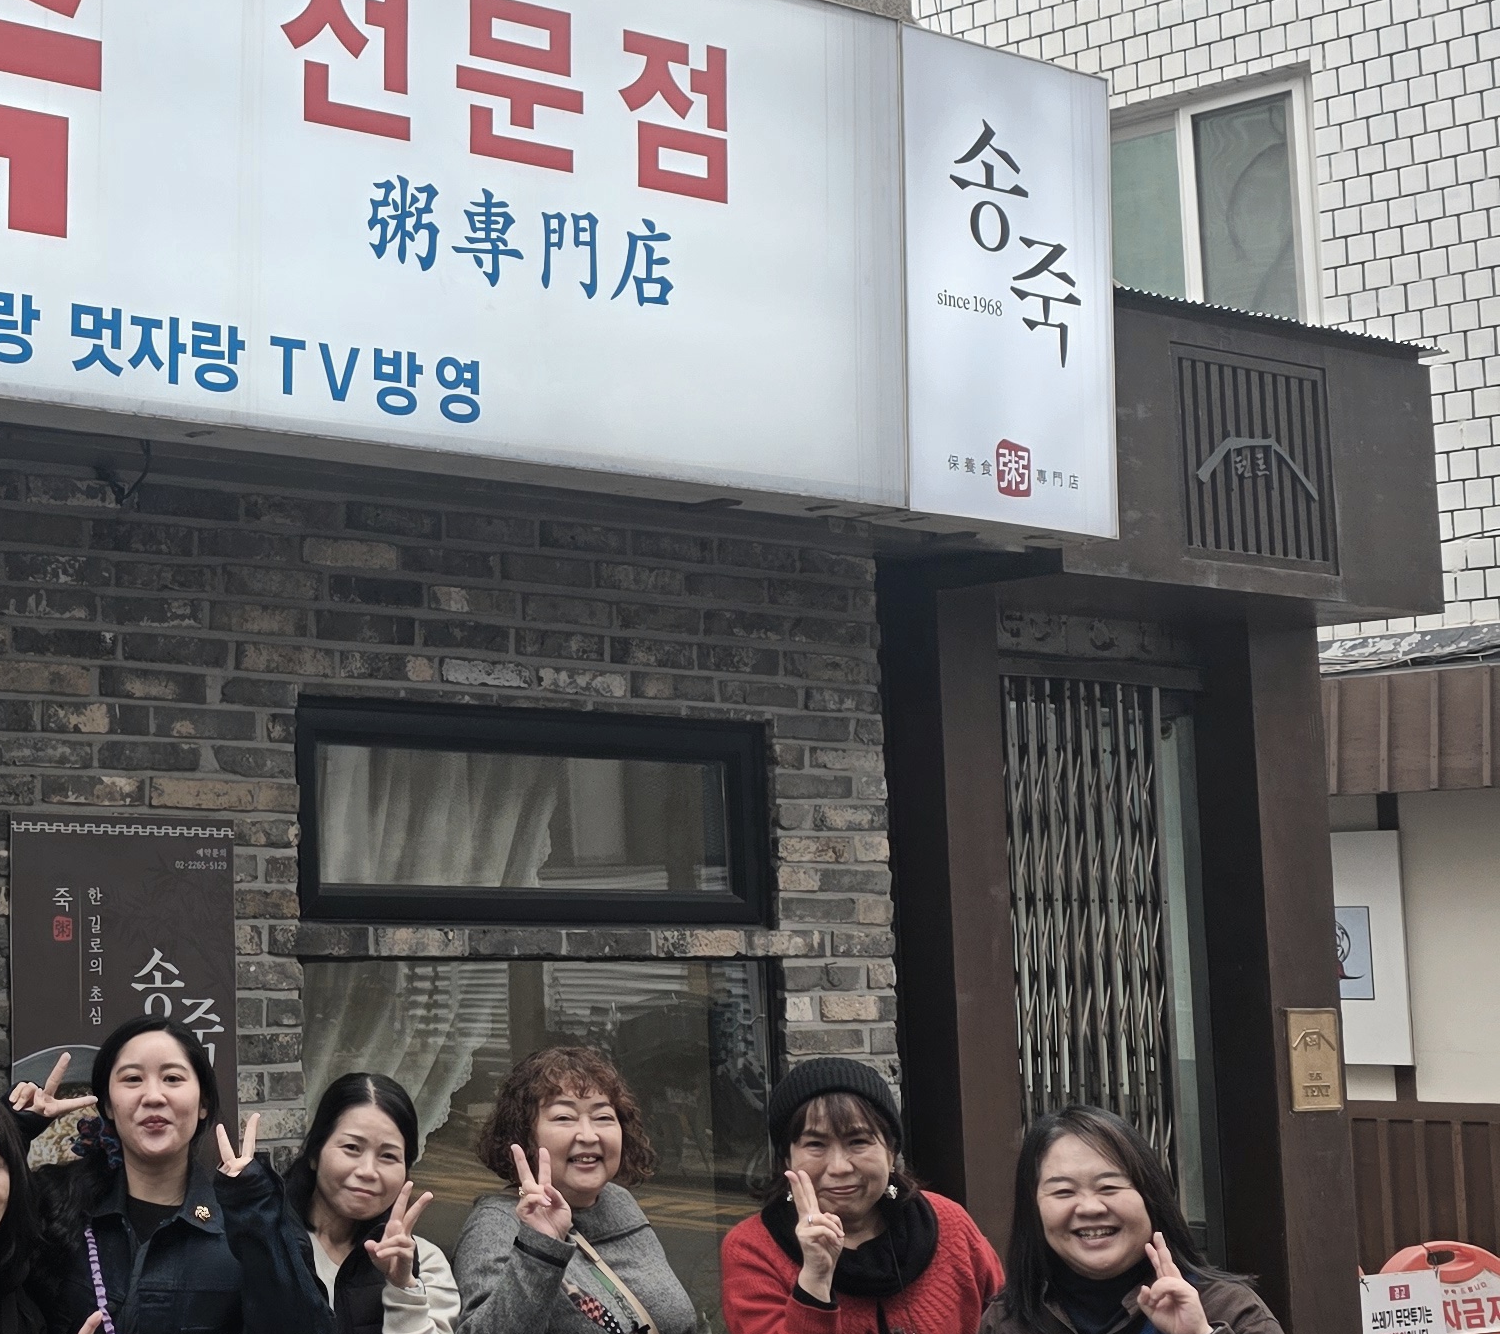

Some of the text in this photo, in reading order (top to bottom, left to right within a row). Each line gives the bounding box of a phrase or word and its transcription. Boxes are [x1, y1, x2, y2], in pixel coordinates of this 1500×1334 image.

[368, 175, 674, 306] 粥專門店
[937, 289, 1003, 316] since 1968
[70, 302, 246, 393] 멋자랑
[175, 860, 227, 870] 02-2265-5129
[52, 887, 73, 911] 죽
[88, 887, 103, 1025] 한 길로의 초심
[1372, 1305, 1433, 1330] 쓰레기 무단투기는
